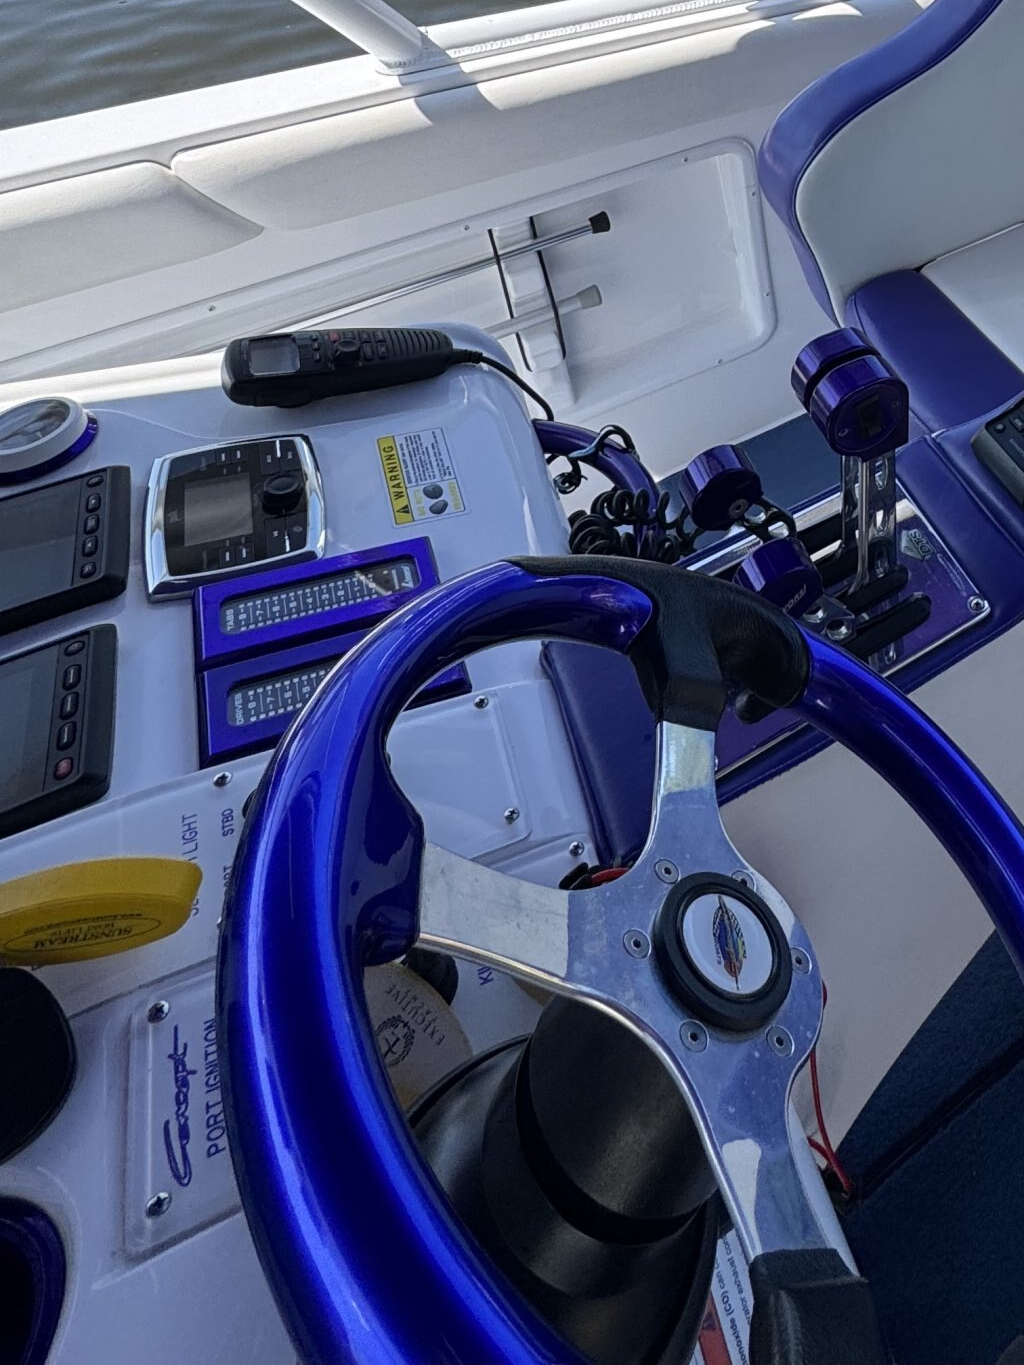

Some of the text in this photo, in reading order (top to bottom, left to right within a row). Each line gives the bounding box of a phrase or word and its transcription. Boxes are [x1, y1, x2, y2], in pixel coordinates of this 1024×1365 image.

[382, 445, 406, 501] WARNING
[908, 528, 934, 556] DTS
[226, 609, 235, 632] TABS
[234, 693, 244, 726] DRIVES
[182, 813, 198, 856] LIGHT
[221, 808, 234, 838] STBD
[33, 926, 133, 949] SUNSTREAM
[385, 983, 446, 1046] EXECUTIVE
[203, 1017, 226, 1158] PORT IGNITION
[716, 1270, 726, 1290] can
[727, 1255, 744, 1294] exhaust
[720, 1290, 735, 1317] (CO)
